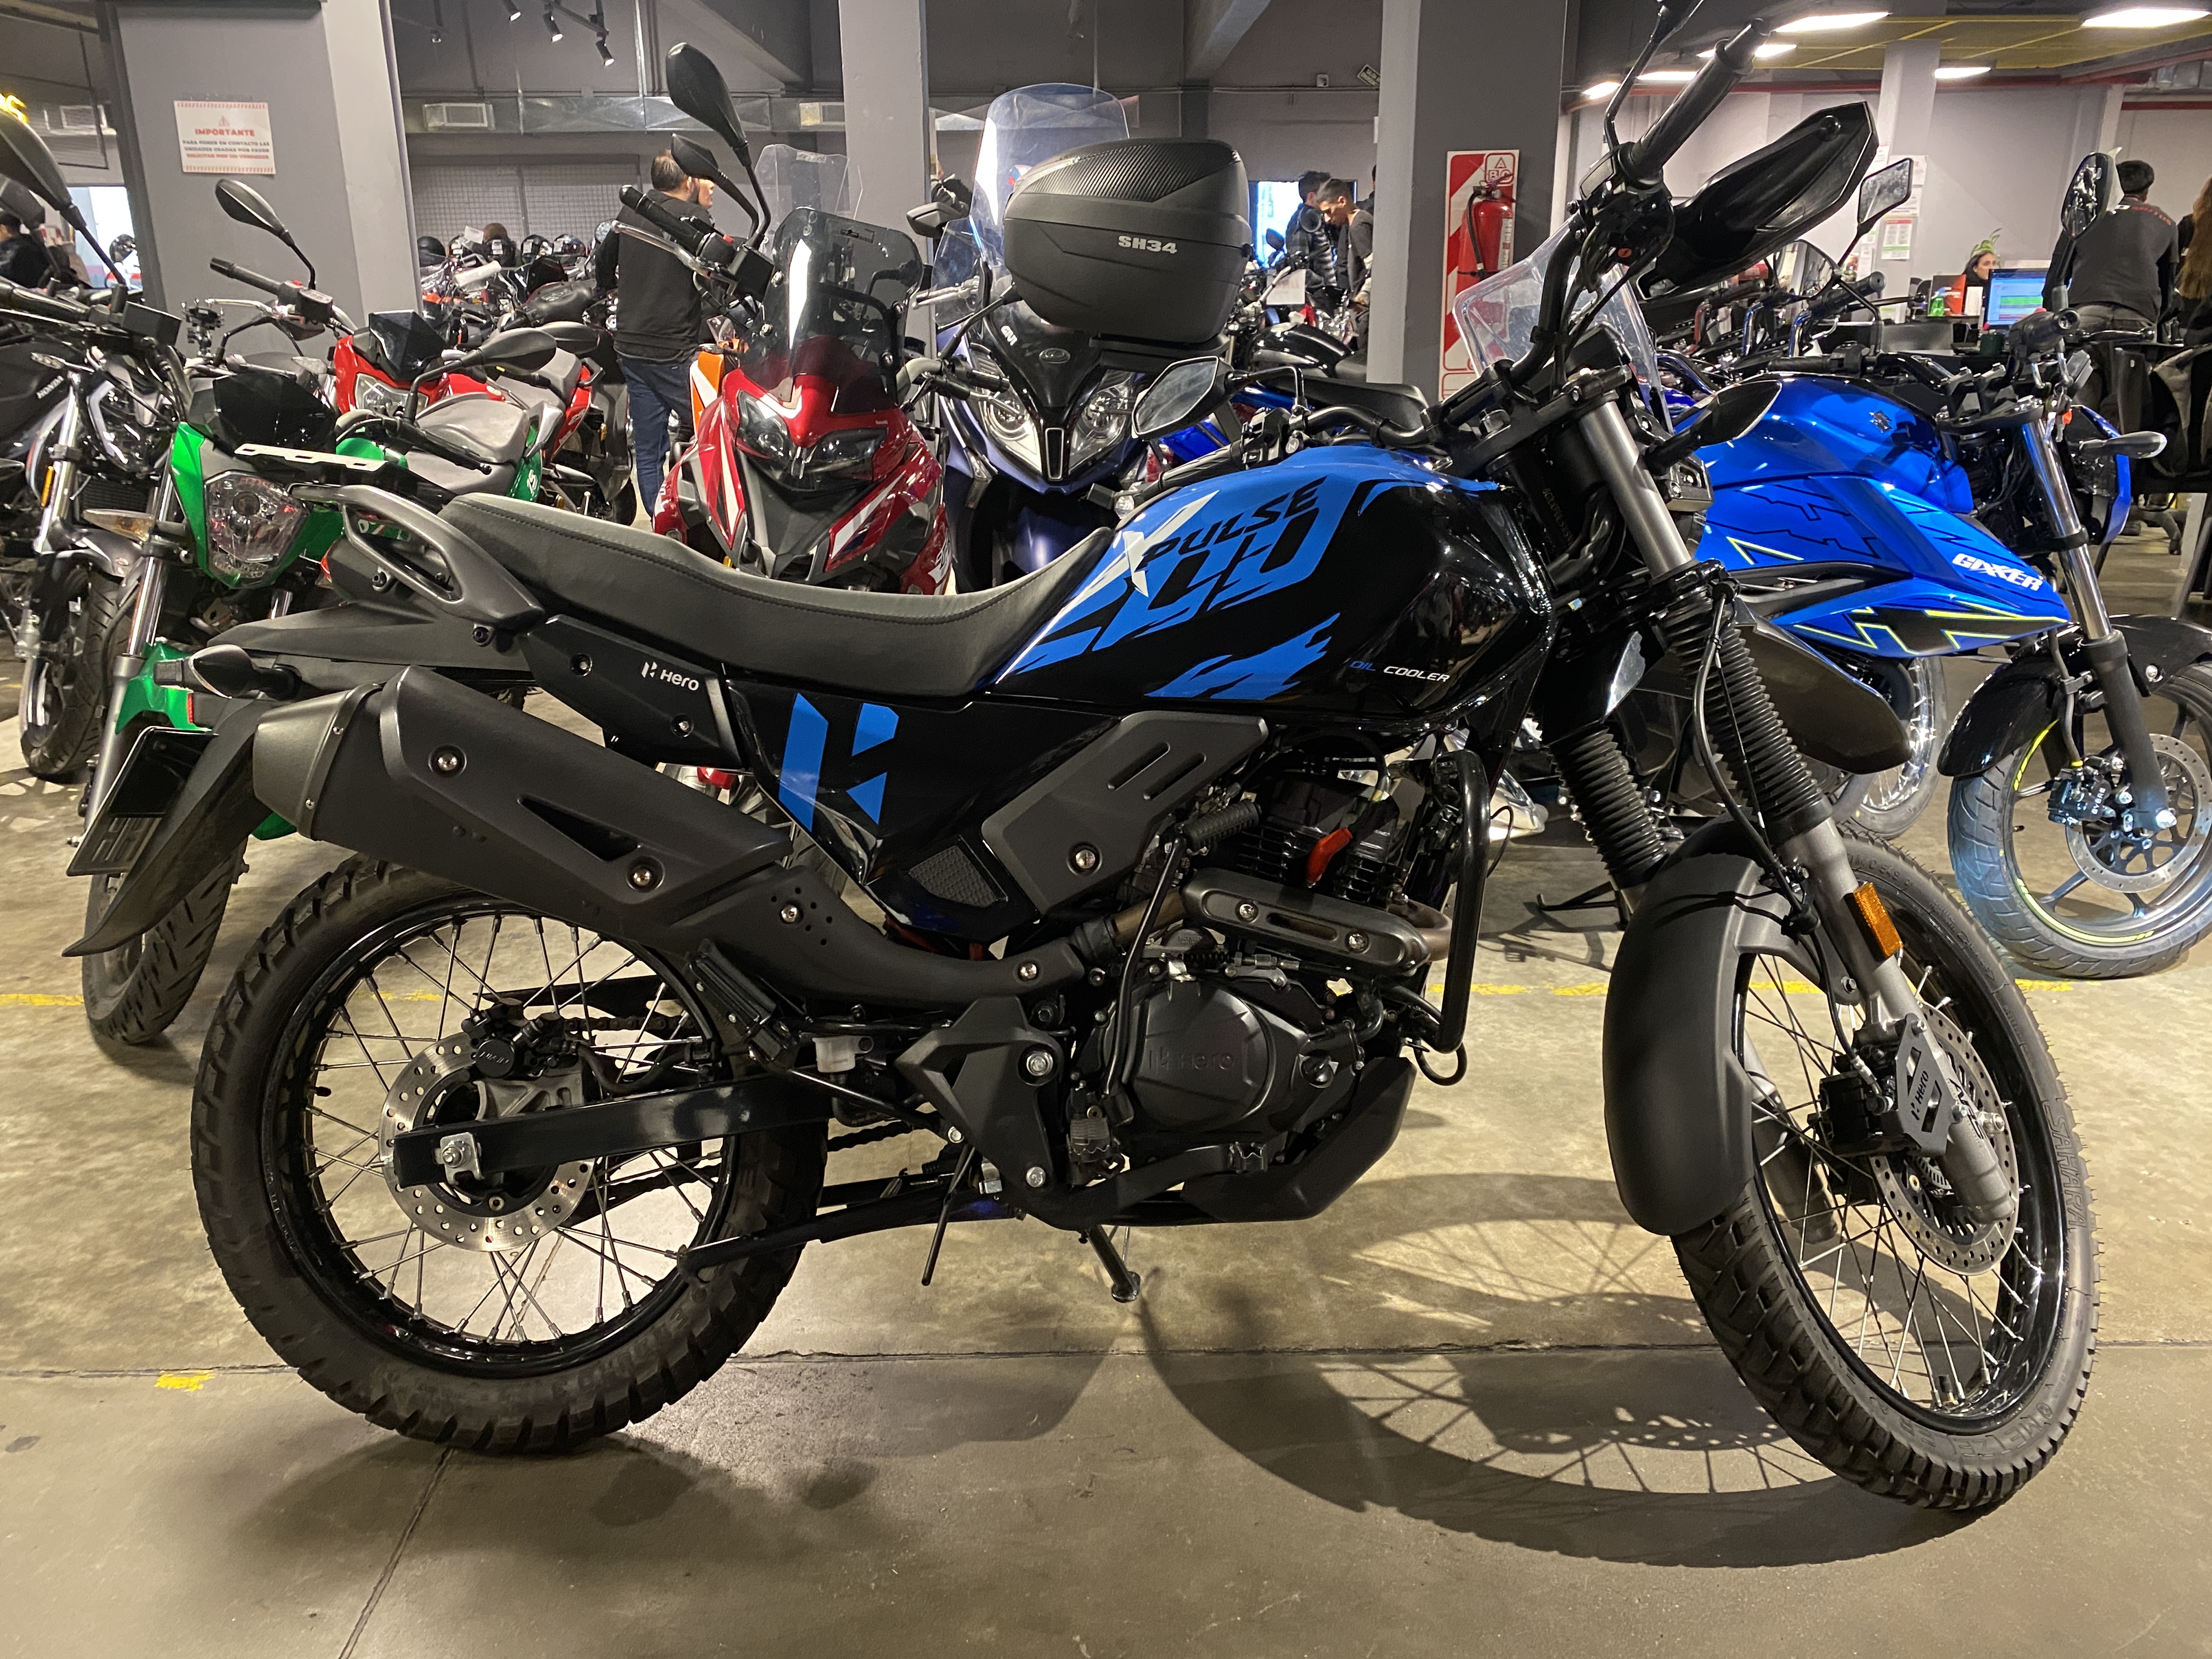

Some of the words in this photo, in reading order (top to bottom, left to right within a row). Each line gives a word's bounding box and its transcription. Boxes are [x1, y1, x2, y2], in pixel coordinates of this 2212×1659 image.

[1118, 235, 1177, 254] SH34
[36, 375, 64, 399] HONDA
[1952, 553, 2043, 591] GIXXER
[660, 669, 699, 691] Hero
[1349, 660, 1376, 671] OIL
[1383, 666, 1451, 682] COOLER
[1915, 1070, 1929, 1104] Hero
[2046, 1103, 2087, 1229] SAHARA
